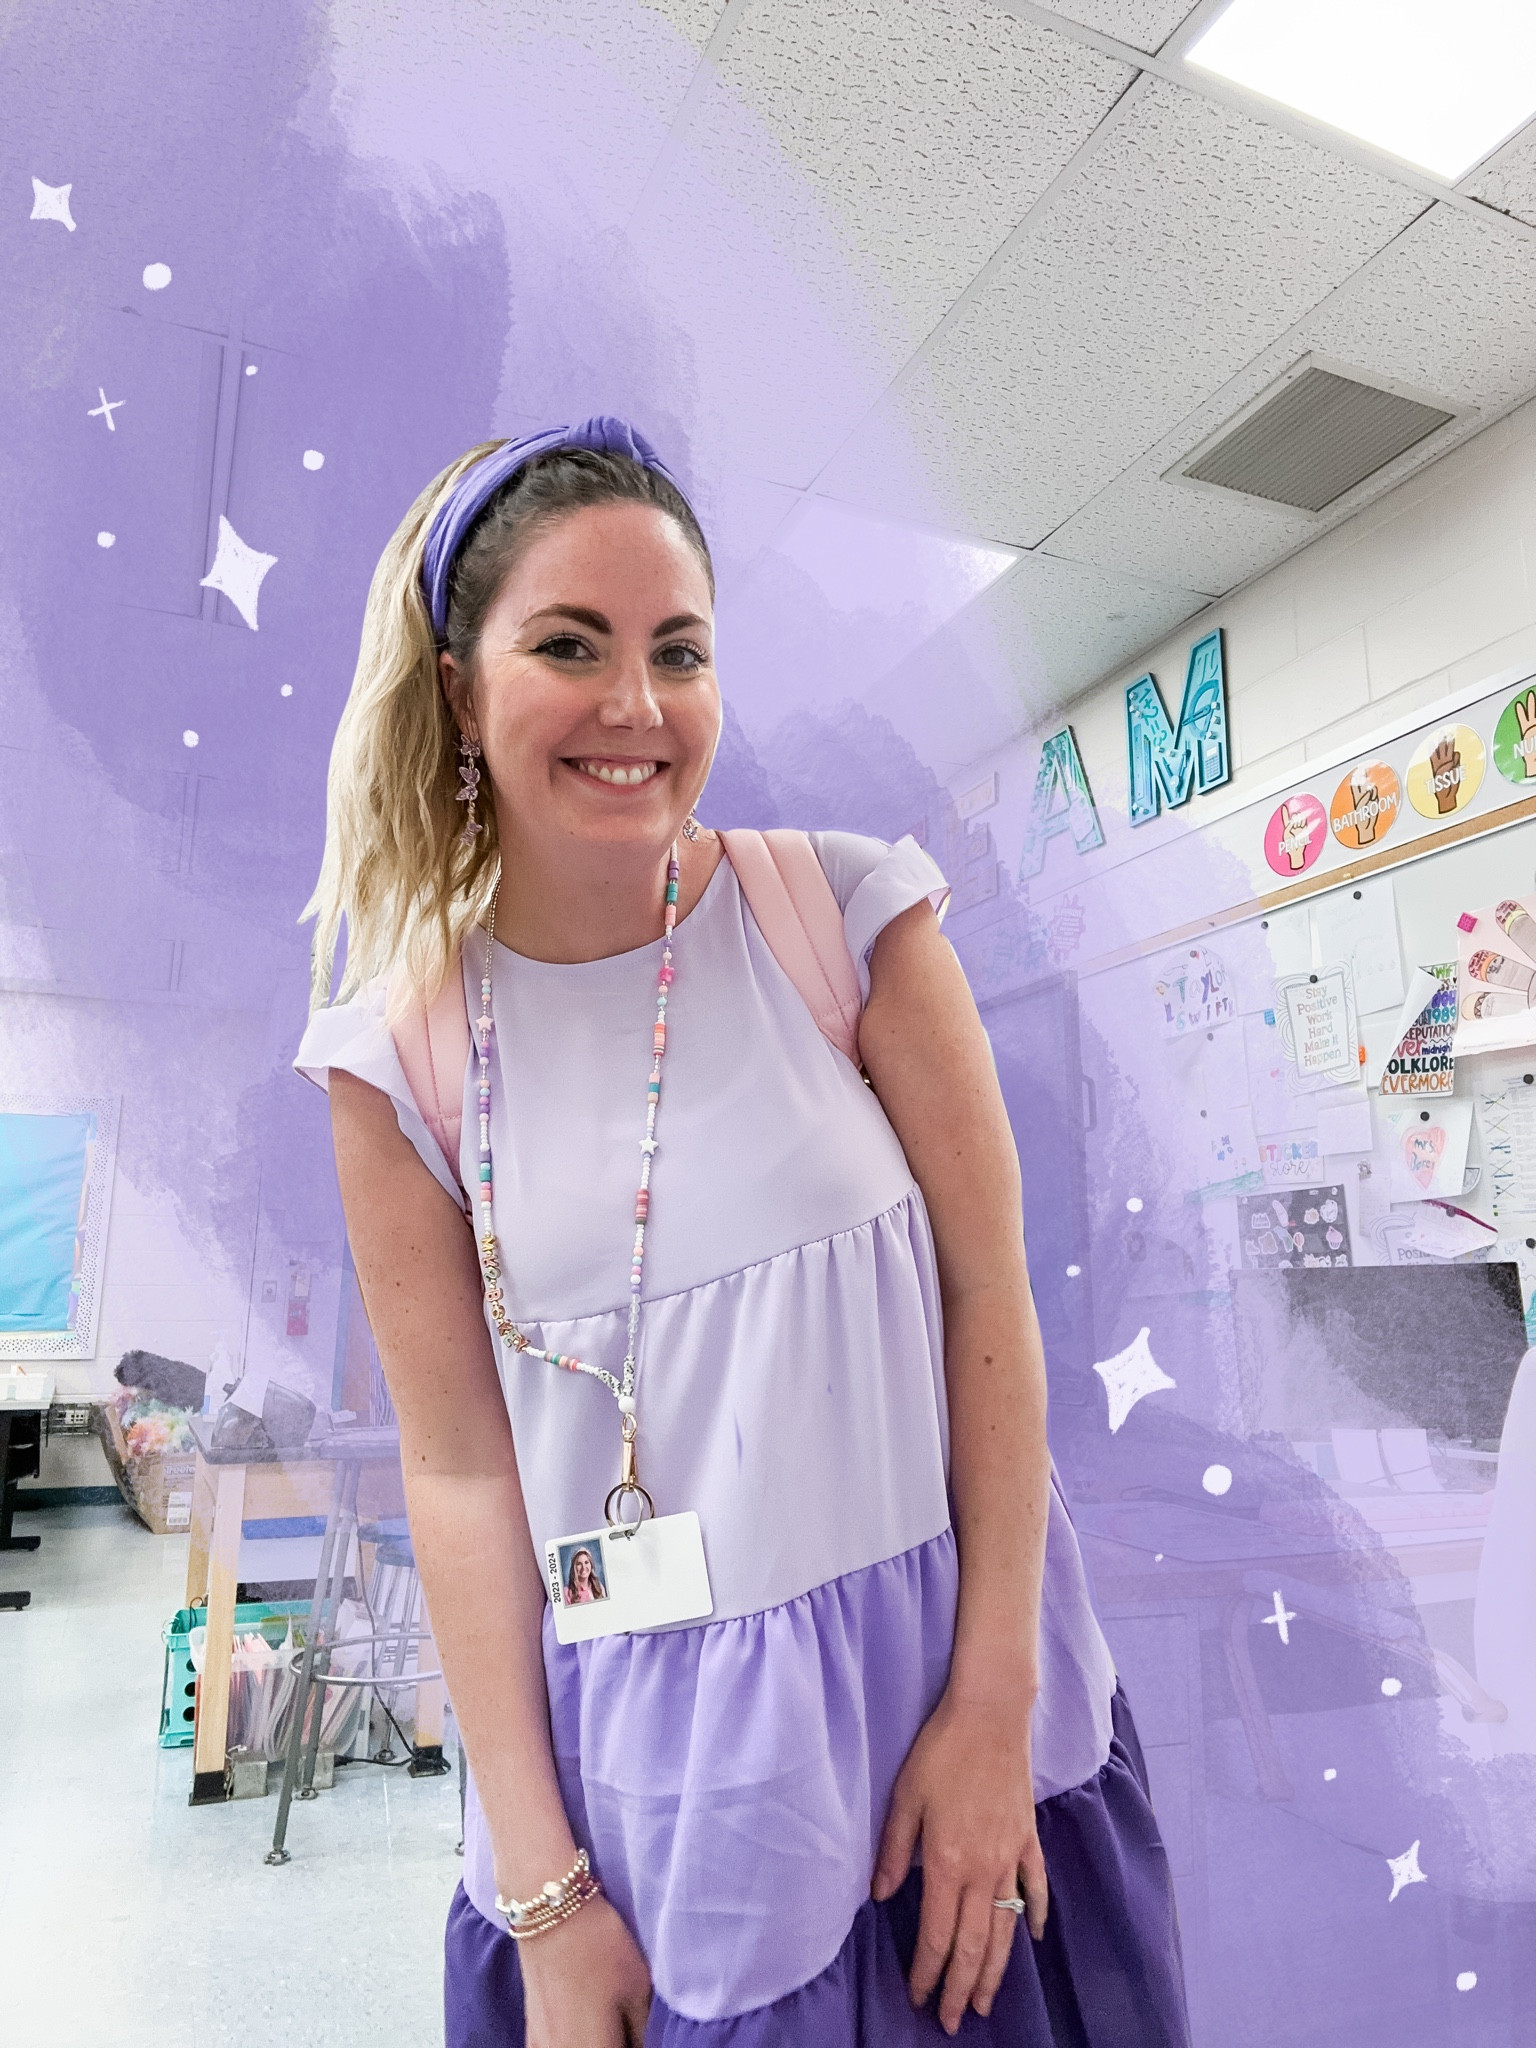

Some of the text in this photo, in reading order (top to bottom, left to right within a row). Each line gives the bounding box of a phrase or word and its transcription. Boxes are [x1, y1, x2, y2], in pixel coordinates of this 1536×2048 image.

[1425, 765, 1467, 795] TISSUE
[1332, 795, 1397, 832] BATHROOM
[1278, 835, 1312, 856] PENCIL
[1306, 985, 1328, 999] Stay
[1297, 995, 1338, 1015] Positive
[1426, 1005, 1457, 1025] 1989
[1306, 1010, 1332, 1025] Work
[1308, 1022, 1333, 1039] Hard
[1304, 1048, 1341, 1067] Happen
[1387, 1056, 1454, 1074] OLKLORE
[548, 1553, 557, 1574] 2024
[553, 1582, 562, 1603] 2023
